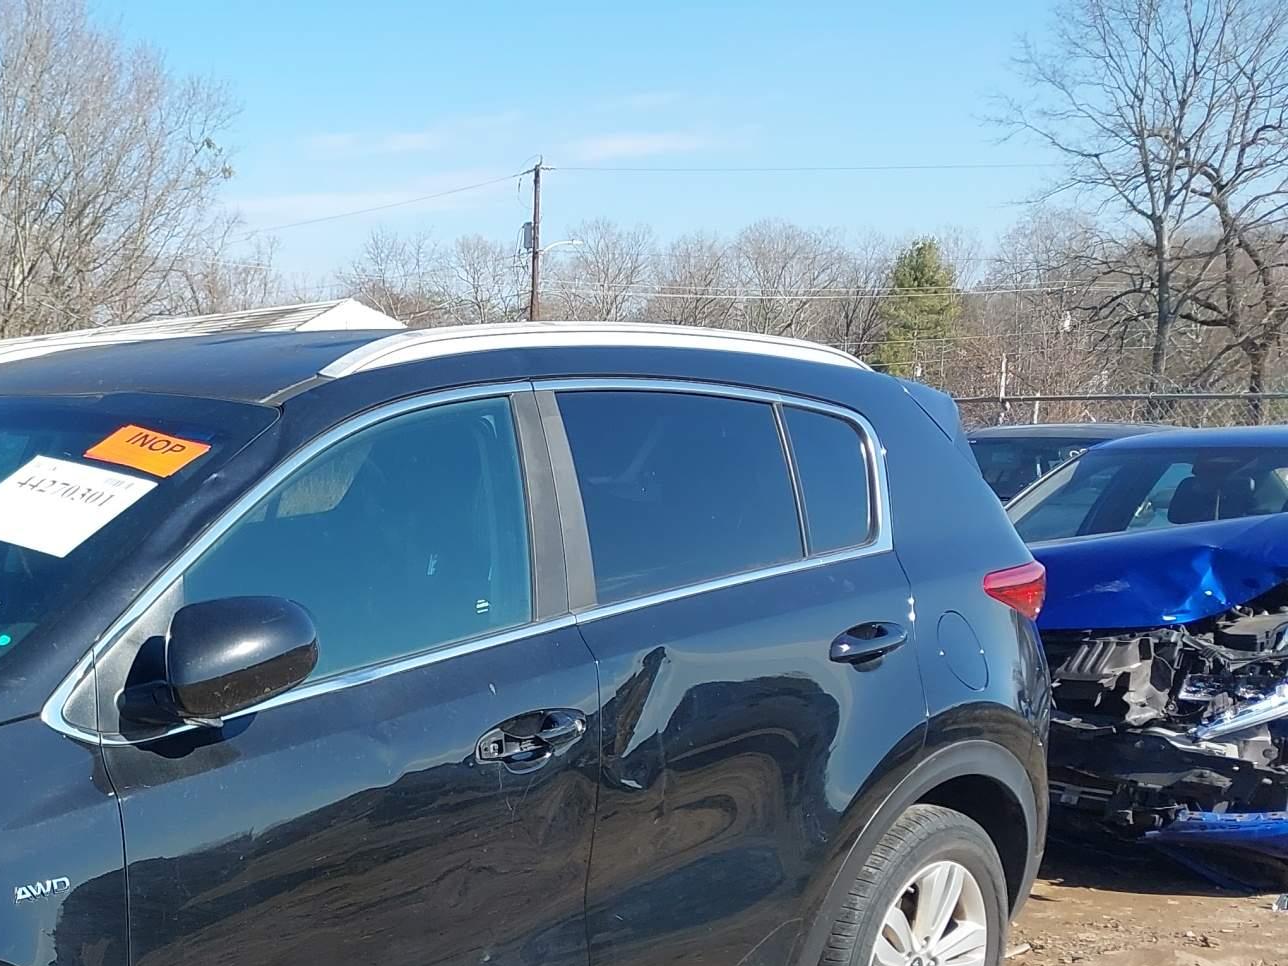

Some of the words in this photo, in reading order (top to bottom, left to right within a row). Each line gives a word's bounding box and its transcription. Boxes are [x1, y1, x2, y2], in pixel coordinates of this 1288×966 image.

[125, 432, 186, 455] INOP
[17, 475, 115, 507] 44270301
[14, 876, 71, 903] AWD
